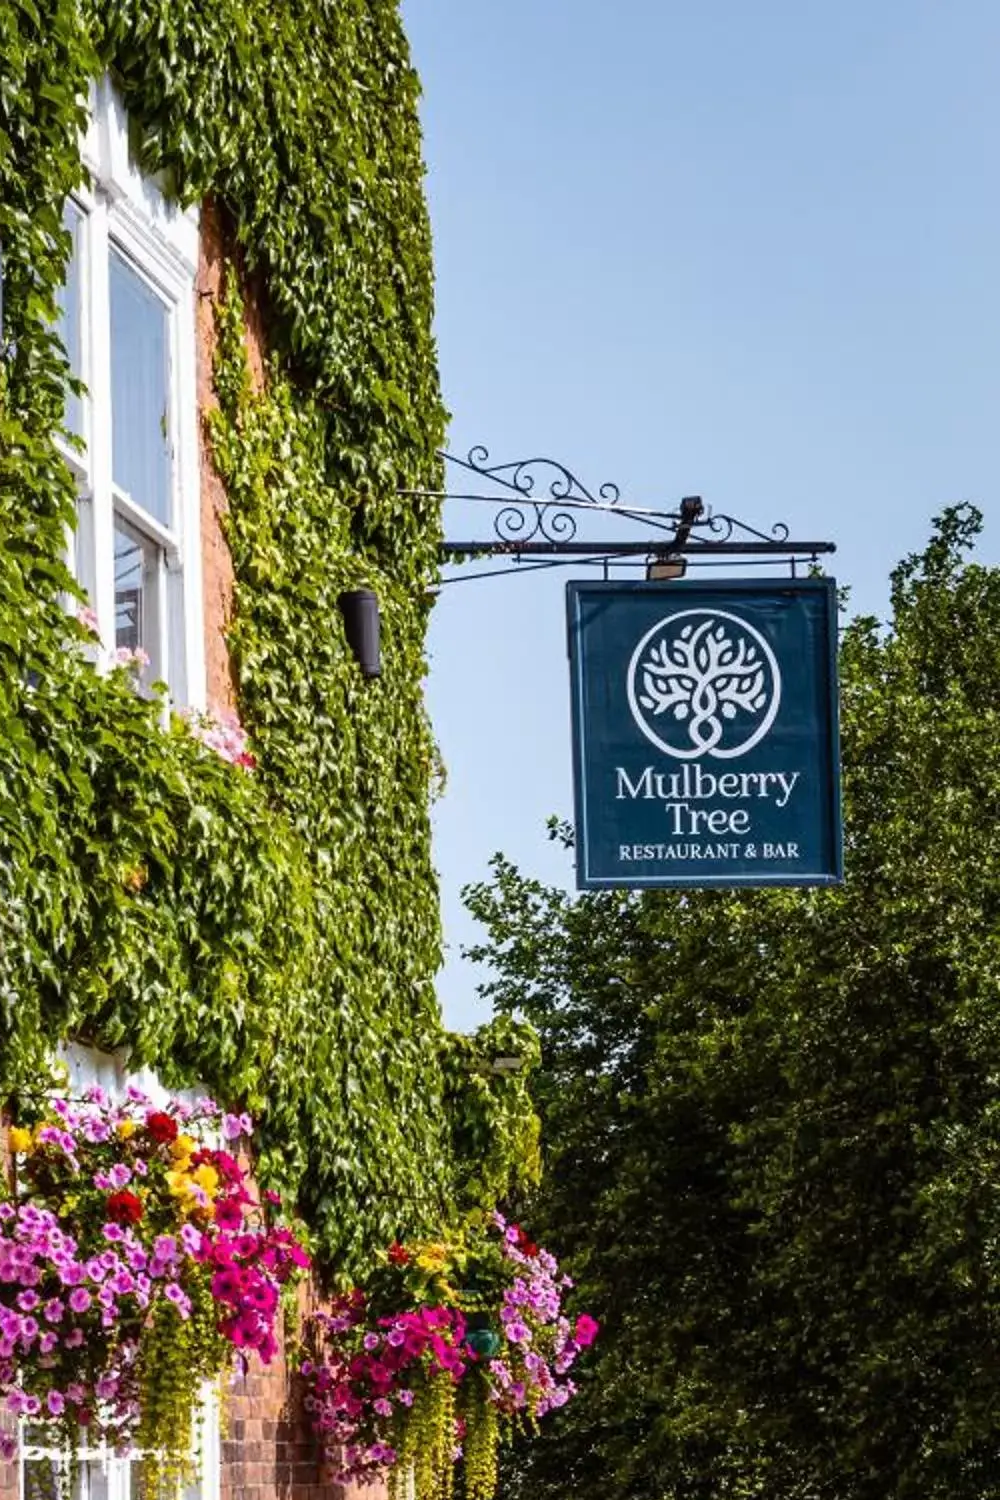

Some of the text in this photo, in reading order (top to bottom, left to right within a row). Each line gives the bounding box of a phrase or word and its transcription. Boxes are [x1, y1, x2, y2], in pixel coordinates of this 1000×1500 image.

[615, 764, 800, 807] Mulberry
[665, 803, 751, 835] Tree
[619, 843, 800, 861] RESTAURANT & BAR
